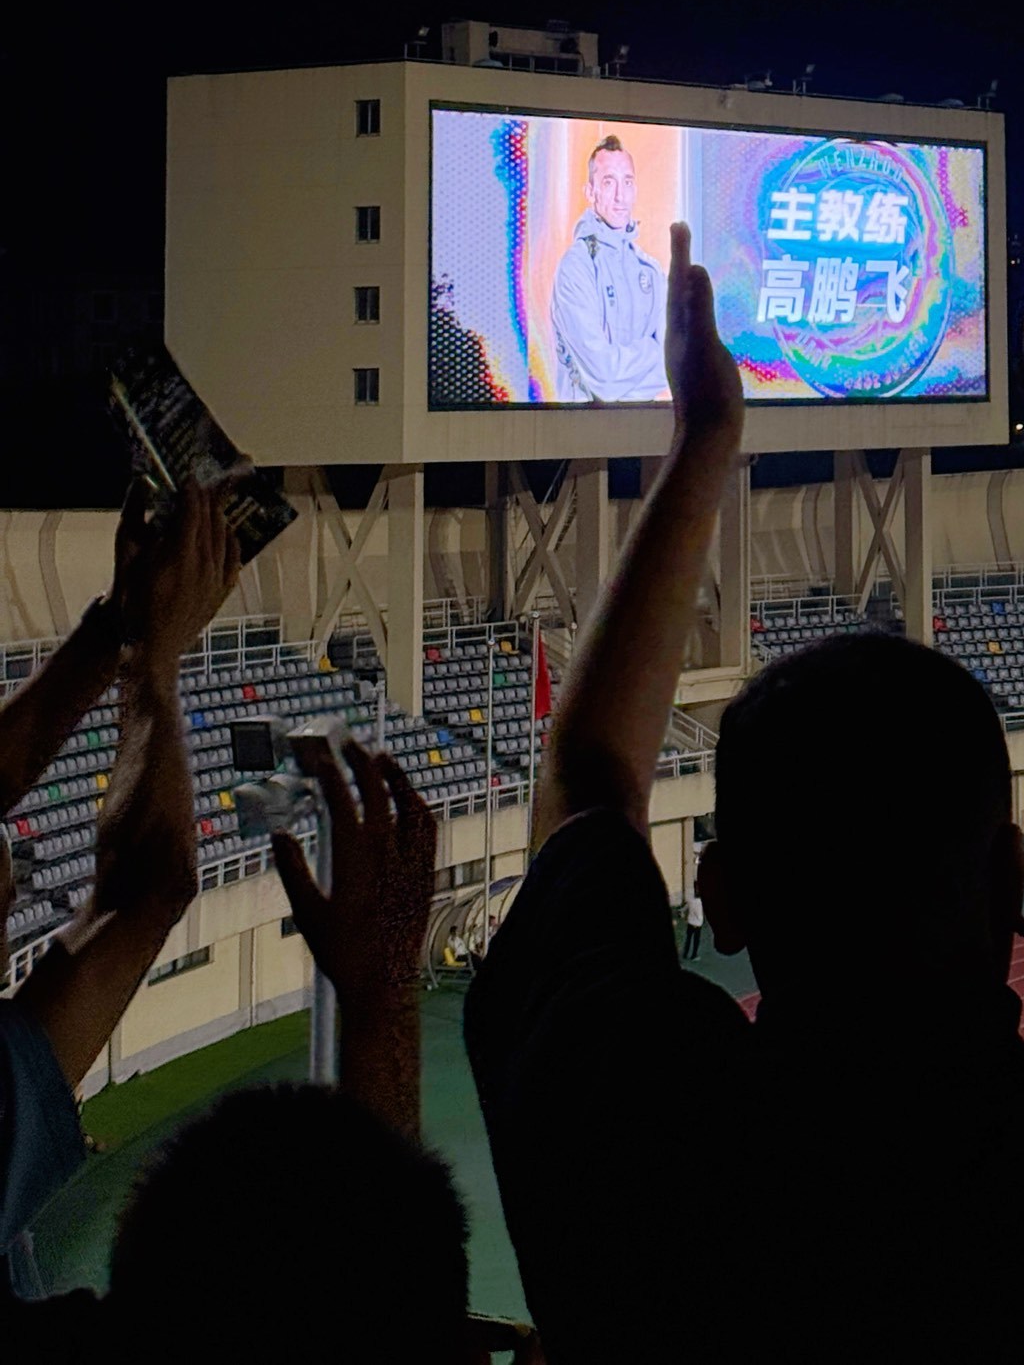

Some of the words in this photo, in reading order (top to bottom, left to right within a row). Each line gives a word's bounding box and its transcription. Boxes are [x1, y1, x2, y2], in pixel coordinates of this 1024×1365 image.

[767, 186, 909, 243] 主教练
[756, 253, 910, 324] 高鹏飞
